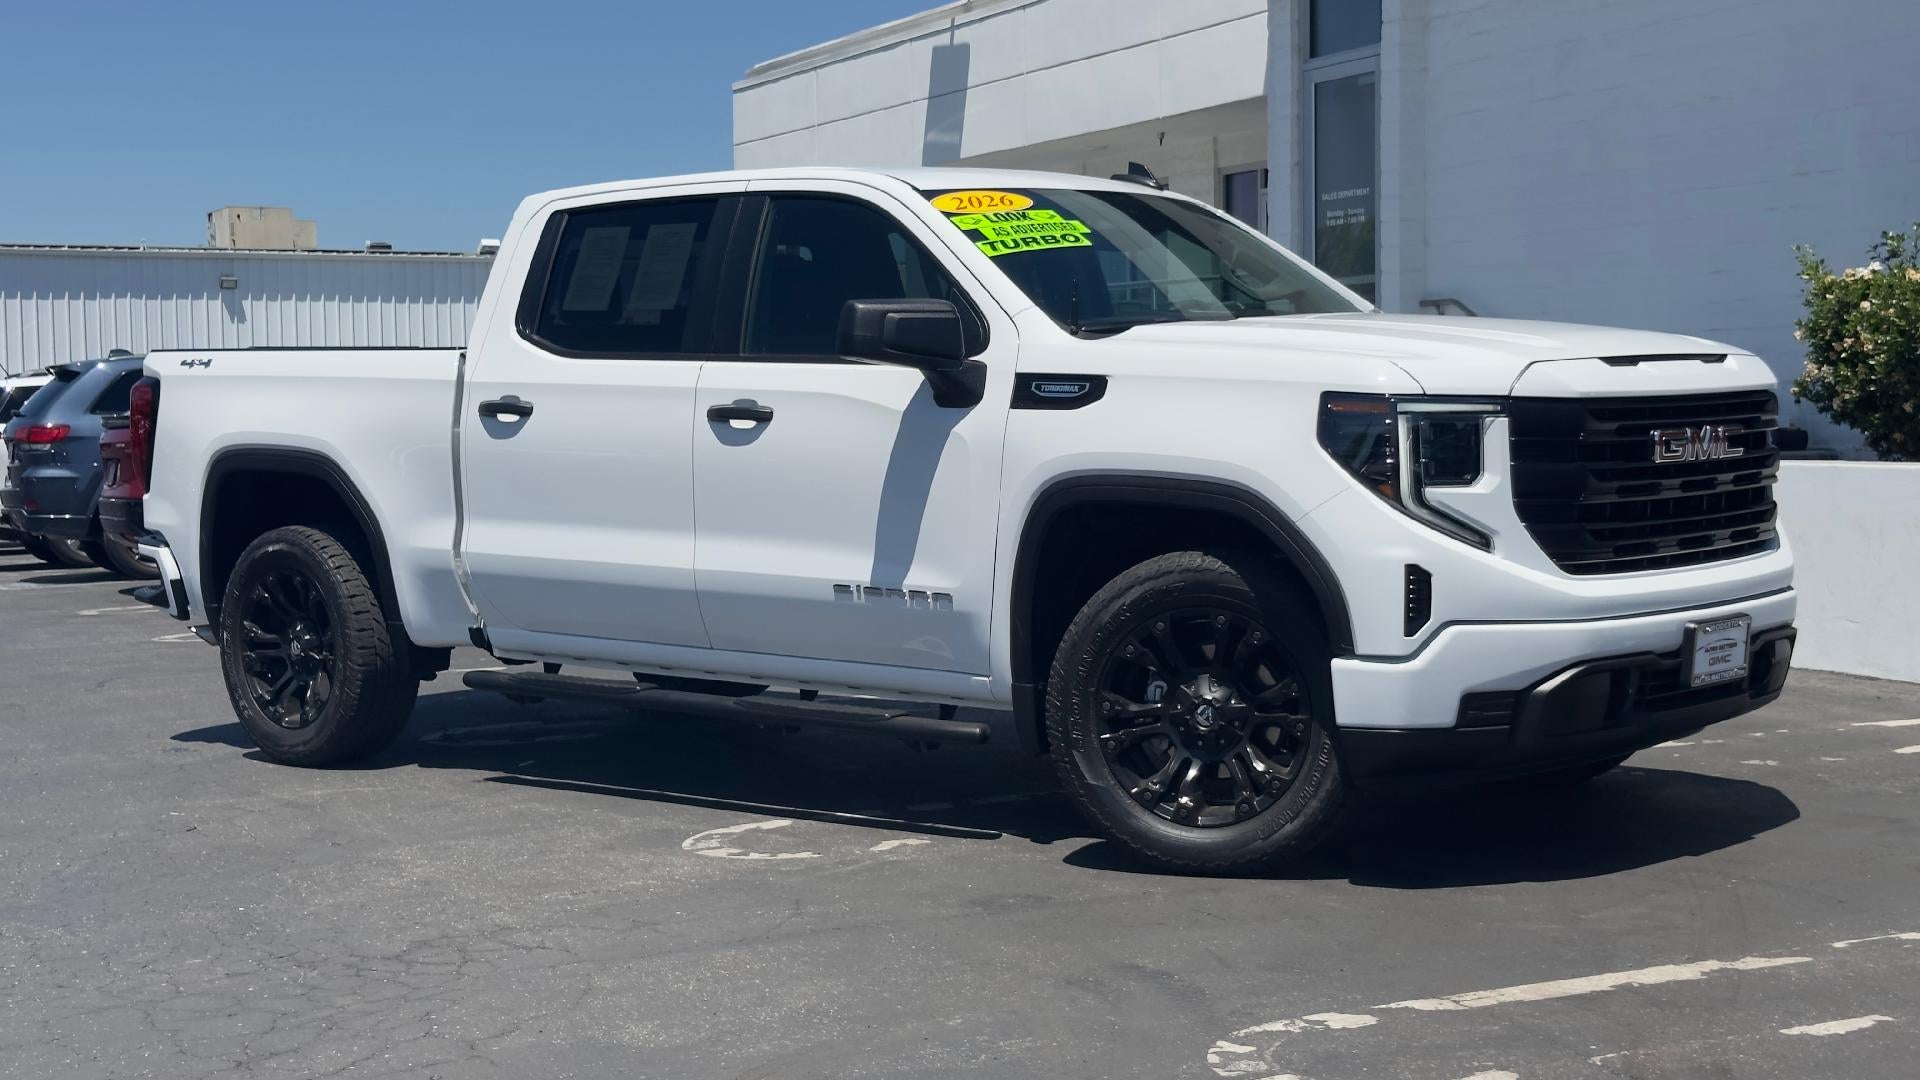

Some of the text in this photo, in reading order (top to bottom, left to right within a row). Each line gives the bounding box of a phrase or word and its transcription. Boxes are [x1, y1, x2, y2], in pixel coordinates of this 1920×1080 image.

[951, 194, 1014, 211] 2026
[982, 211, 1034, 223] LOOK
[992, 222, 1077, 238] AS ADVERTISED
[984, 232, 1081, 252] TURBO
[1650, 425, 1744, 463] GMC
[833, 583, 954, 611] SIERRA
